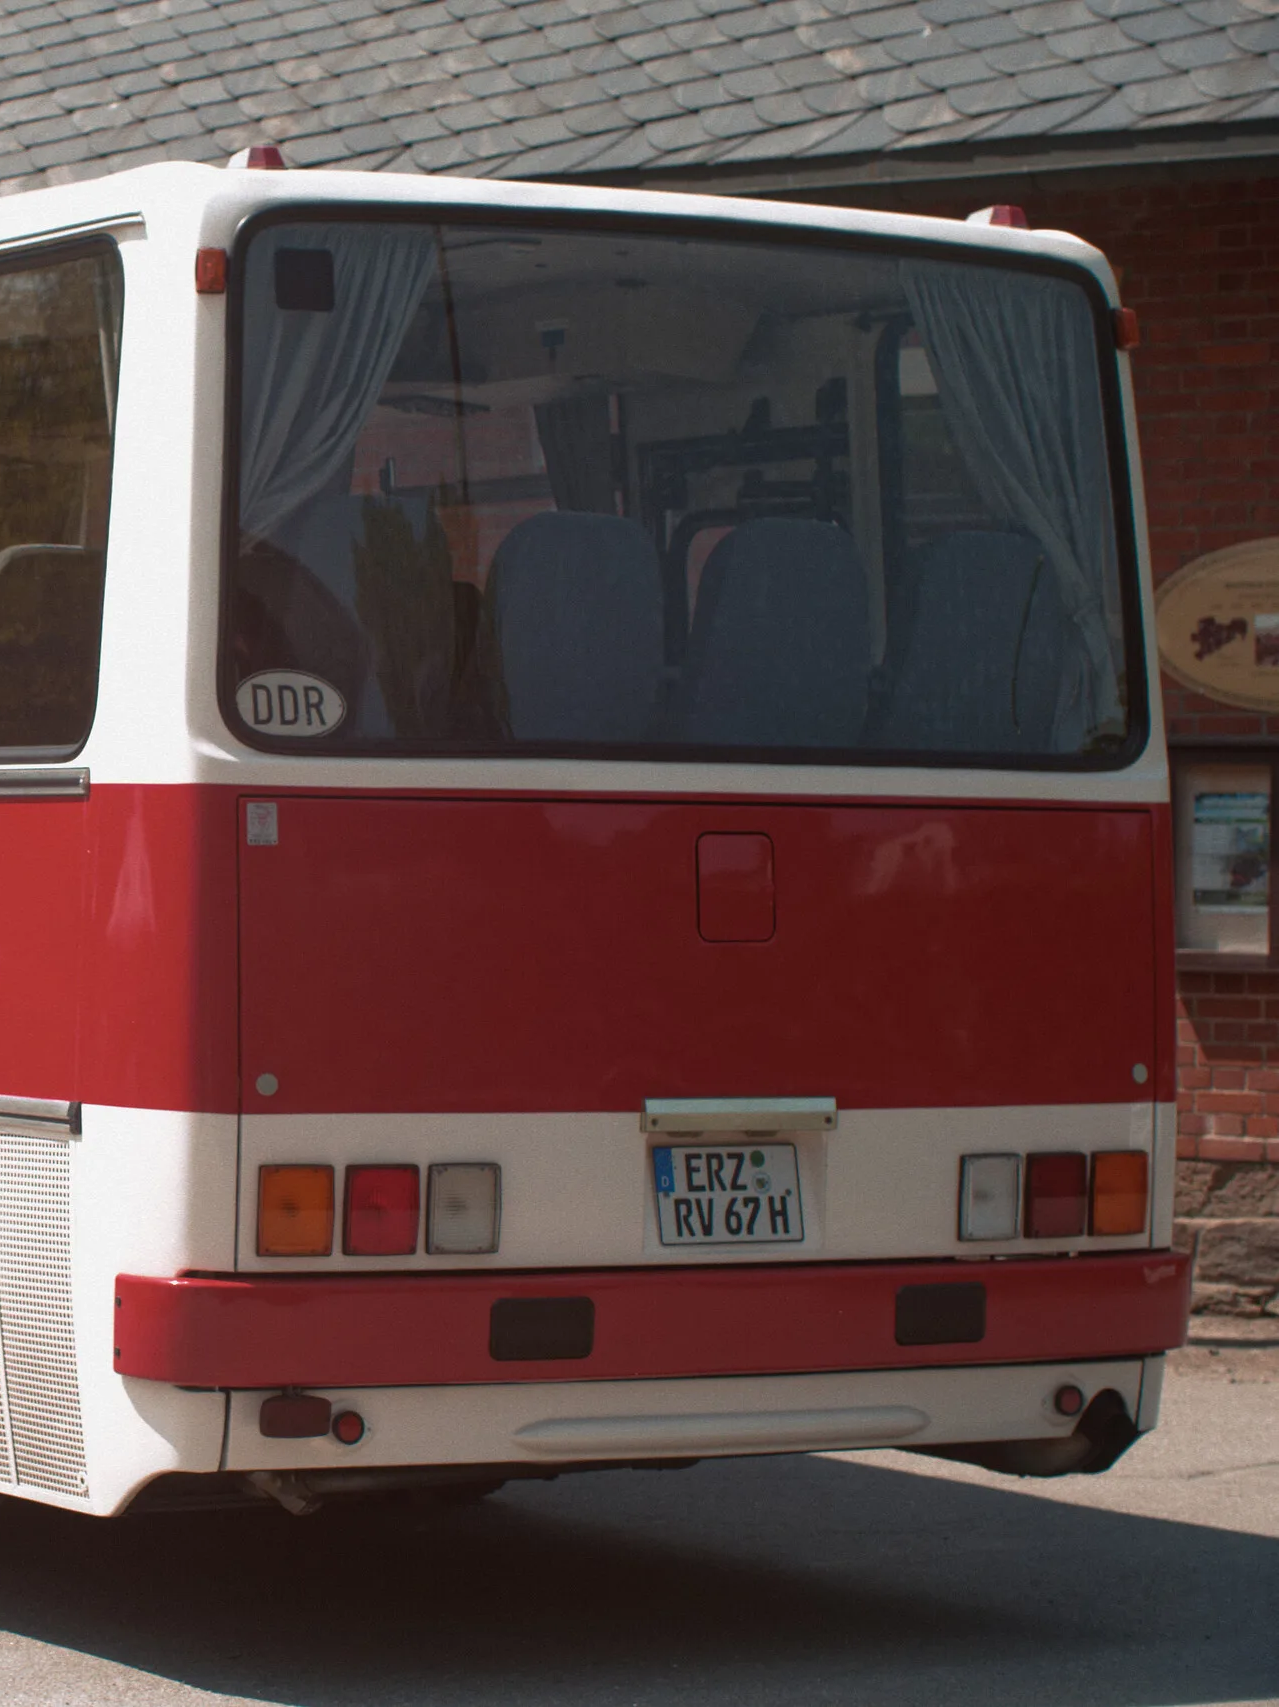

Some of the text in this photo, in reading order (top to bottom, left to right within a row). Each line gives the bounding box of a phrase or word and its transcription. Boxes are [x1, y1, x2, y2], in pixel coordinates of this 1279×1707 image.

[251, 683, 326, 726] DDR
[661, 1175, 670, 1187] D
[684, 1152, 748, 1192] ERZ
[674, 1195, 790, 1237] RV 67 H
